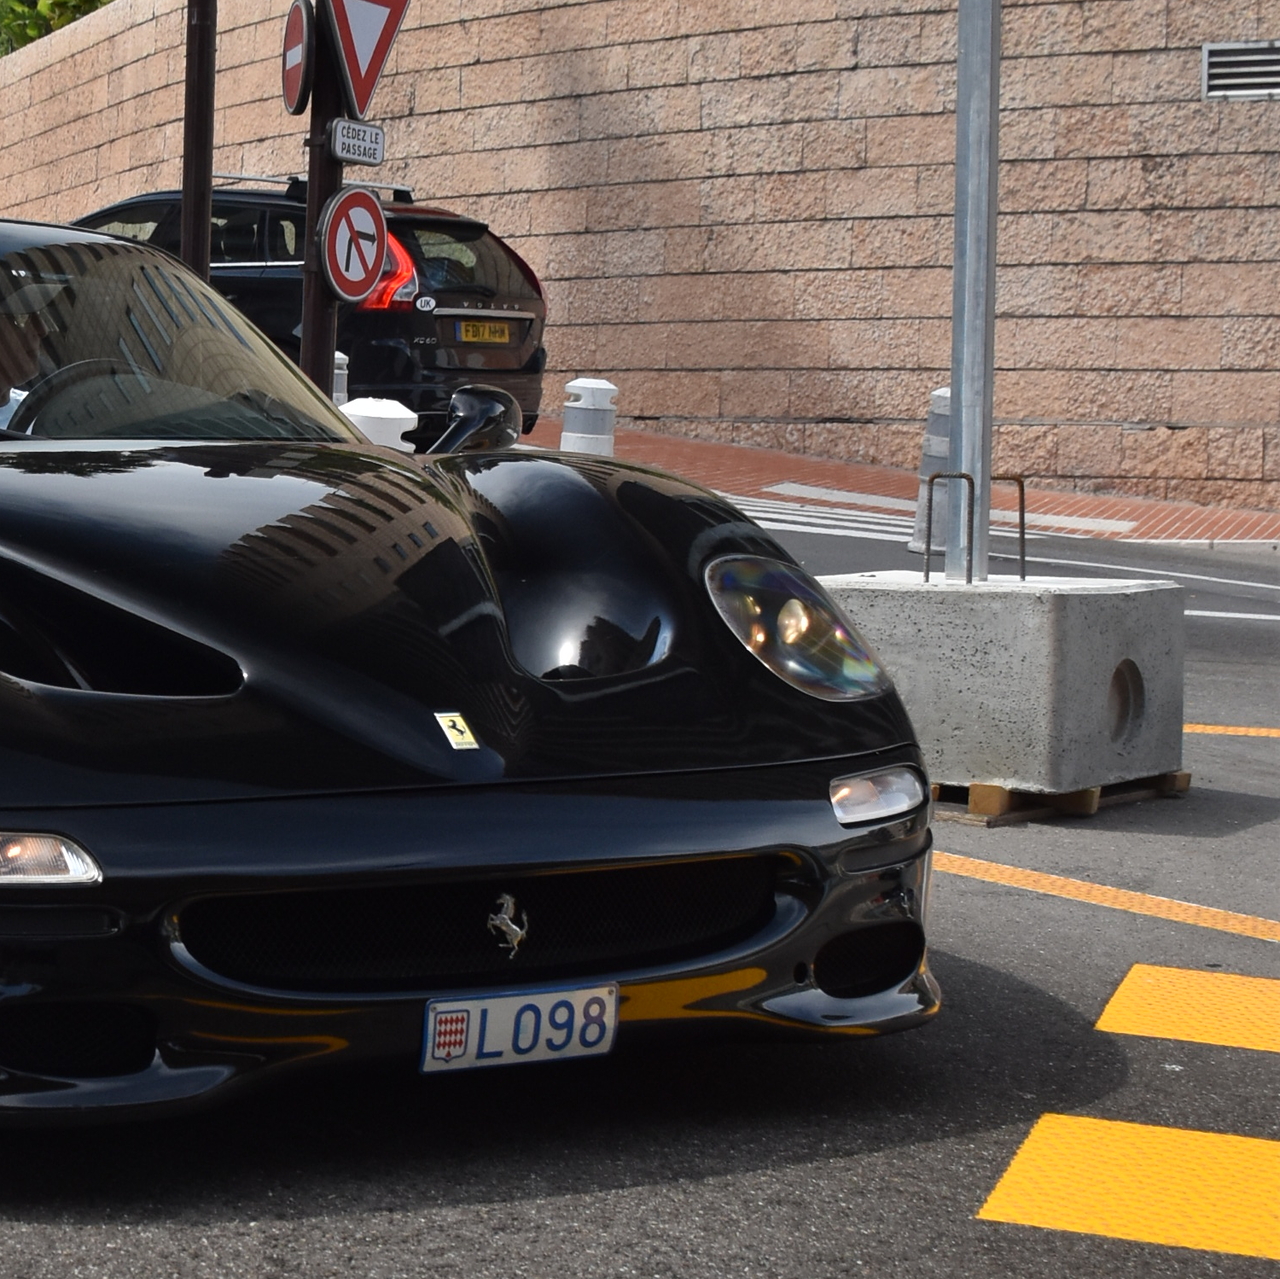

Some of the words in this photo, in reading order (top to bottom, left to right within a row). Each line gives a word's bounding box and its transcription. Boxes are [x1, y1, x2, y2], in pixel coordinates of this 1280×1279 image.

[341, 125, 366, 142] CÉDEZ
[370, 132, 379, 144] LE
[341, 142, 377, 159] PASSAGE
[420, 299, 431, 309] UK
[474, 996, 607, 1060] L098
